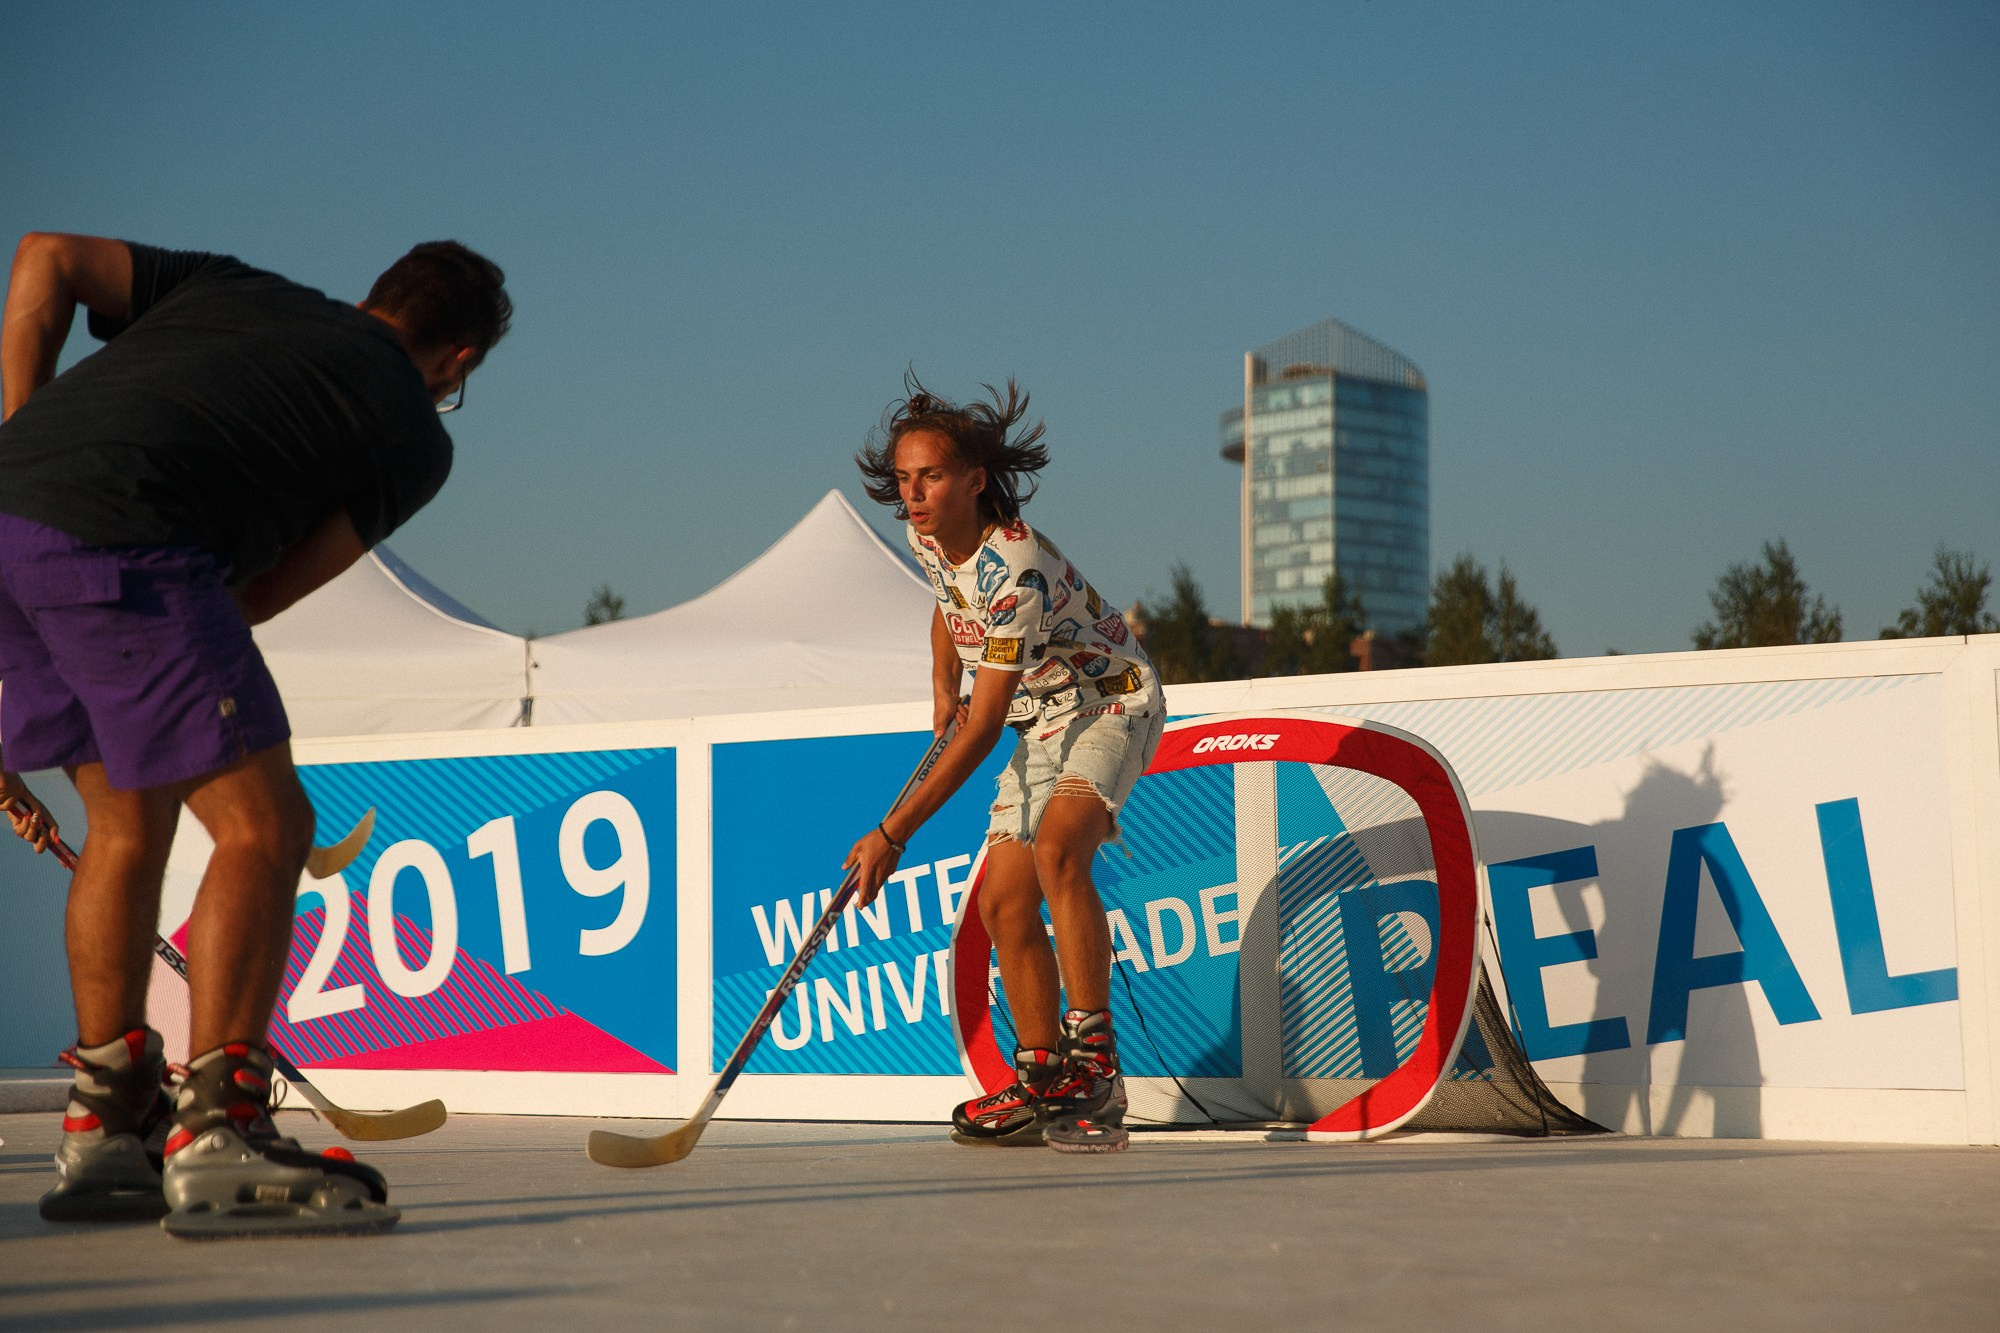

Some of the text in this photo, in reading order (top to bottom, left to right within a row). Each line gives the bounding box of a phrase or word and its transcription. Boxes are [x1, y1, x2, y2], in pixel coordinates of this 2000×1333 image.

[988, 652, 1008, 661] SKATE
[989, 645, 1015, 653] SOCIETY
[991, 638, 1013, 646] SECRET
[918, 739, 948, 782] OXELO
[1192, 733, 1281, 754] OROKS
[287, 790, 651, 1024] 2019
[750, 853, 972, 968] WINTE
[779, 911, 841, 997] RUSSIA
[1339, 796, 1958, 1080] REAL
